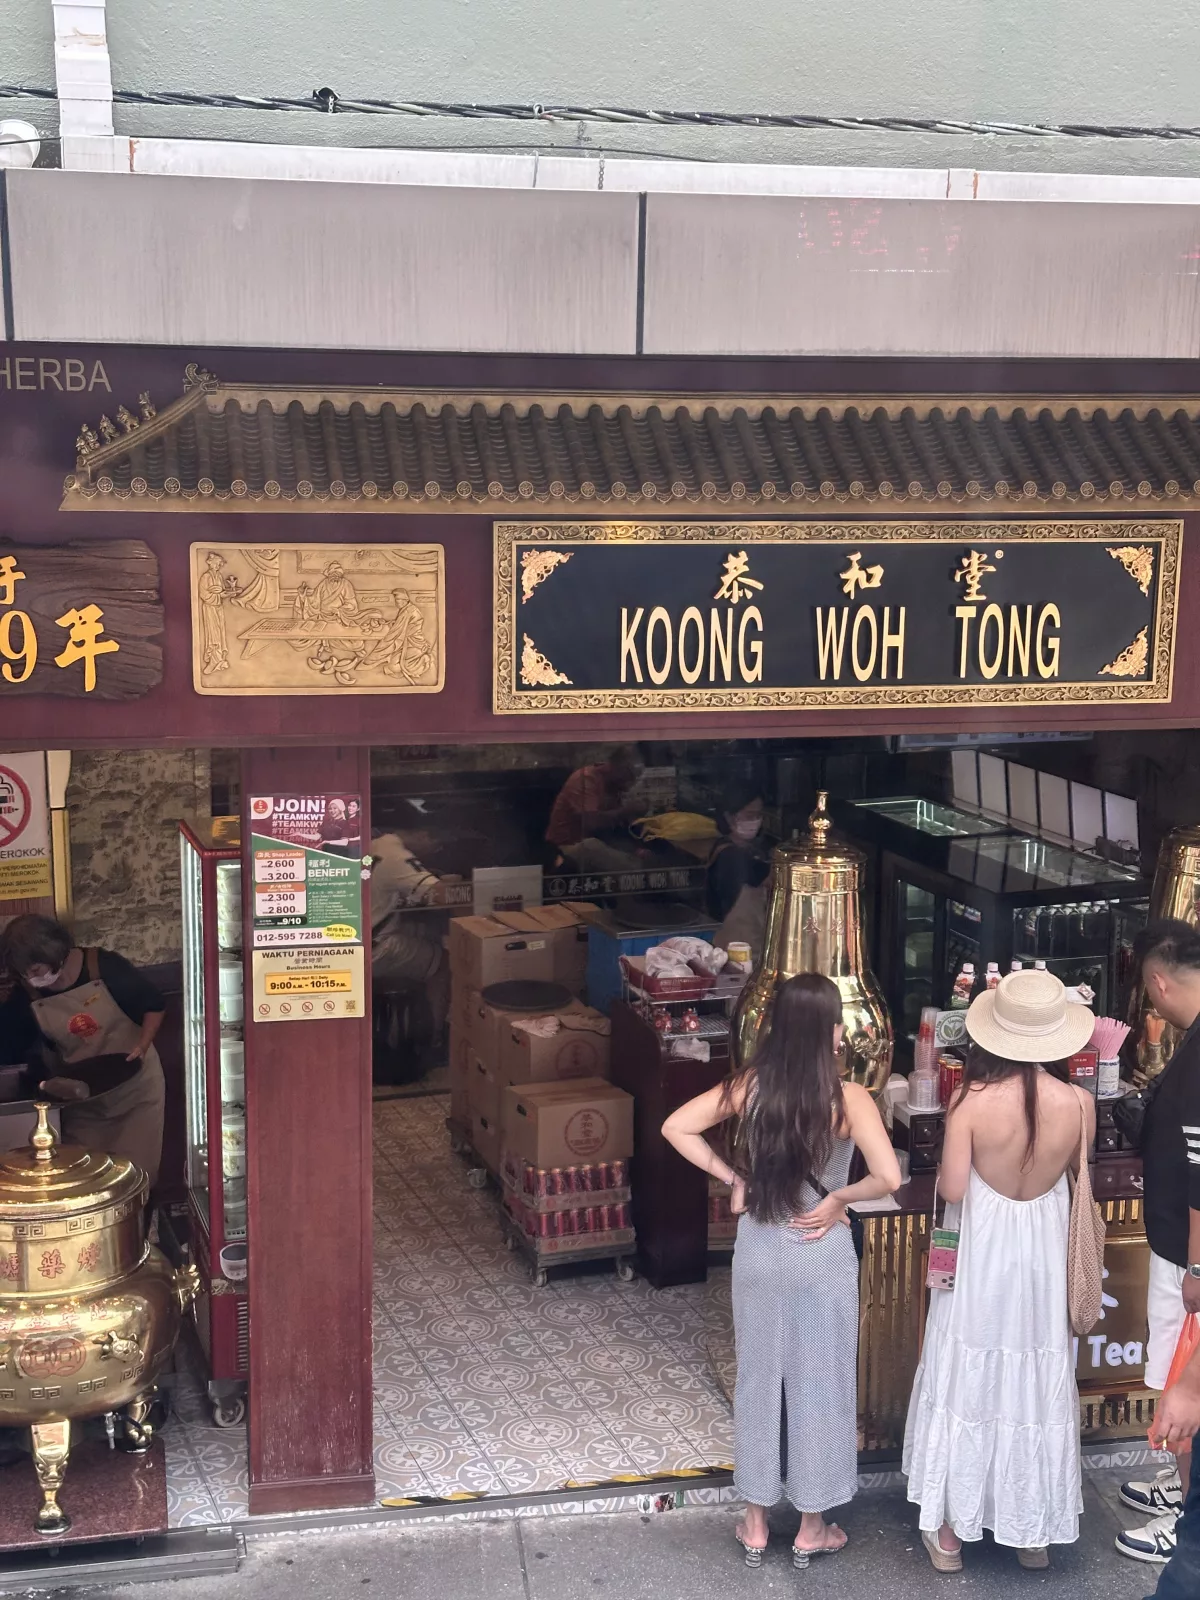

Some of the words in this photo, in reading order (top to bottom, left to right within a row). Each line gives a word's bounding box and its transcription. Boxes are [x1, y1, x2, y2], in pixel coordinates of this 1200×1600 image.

[0, 357, 112, 393] HERBA
[619, 604, 764, 685] KOONG
[816, 605, 906, 682] WOH
[955, 602, 1062, 680] TONG
[274, 798, 326, 813] JOIN!
[267, 860, 295, 869] 2,600
[267, 872, 295, 882] 3,200
[308, 868, 350, 878] BENEFIT
[267, 893, 295, 903] 2,300
[268, 905, 296, 915] 2,800
[257, 932, 296, 942] 012-595
[299, 932, 323, 940] 7288
[262, 950, 294, 958] WAKTU
[297, 949, 354, 957] PERNIAGAAN
[270, 982, 292, 990] 9:00
[310, 980, 336, 988] 10:15
[1087, 1334, 1142, 1368] Tea
